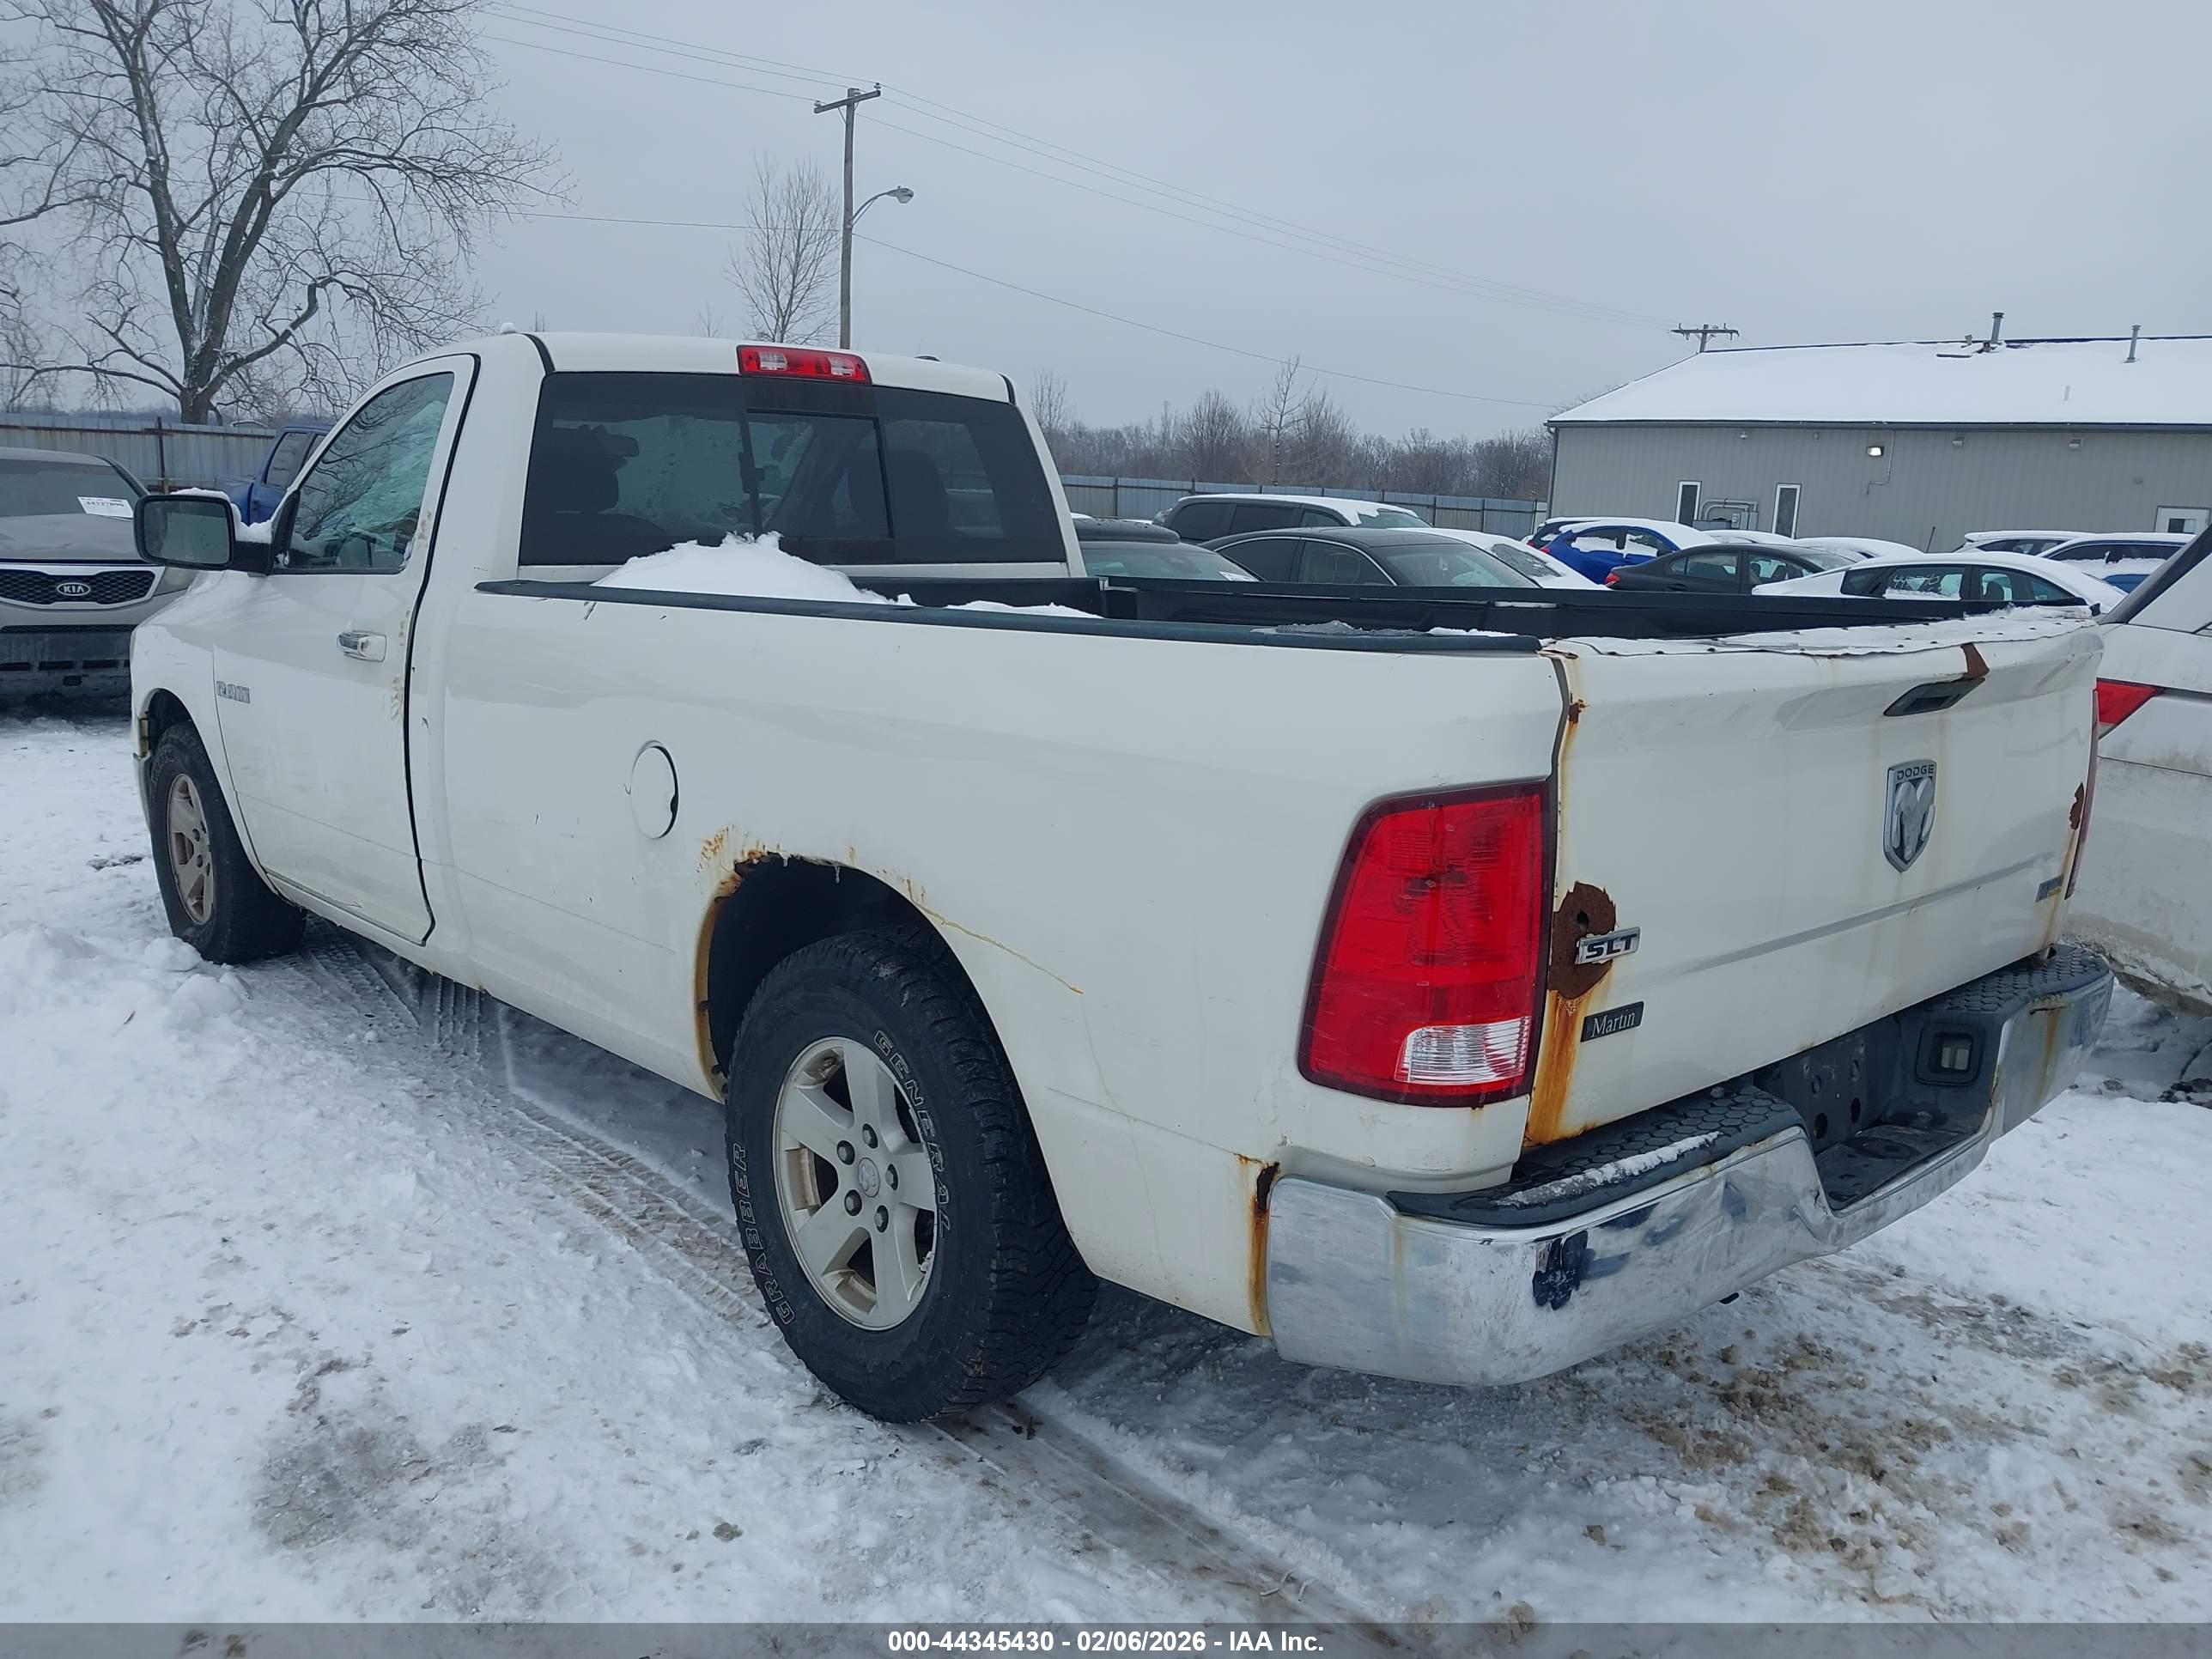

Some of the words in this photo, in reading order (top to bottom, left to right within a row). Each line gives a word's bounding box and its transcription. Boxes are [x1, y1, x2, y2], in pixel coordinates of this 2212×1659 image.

[63, 585, 85, 593] KIA
[1896, 763, 1935, 781] DODGE
[1585, 933, 1638, 959] SLT
[1590, 1009, 1636, 1038] Martin
[873, 1030, 951, 1238] GENERAL
[732, 1142, 796, 1326] GRABBER
